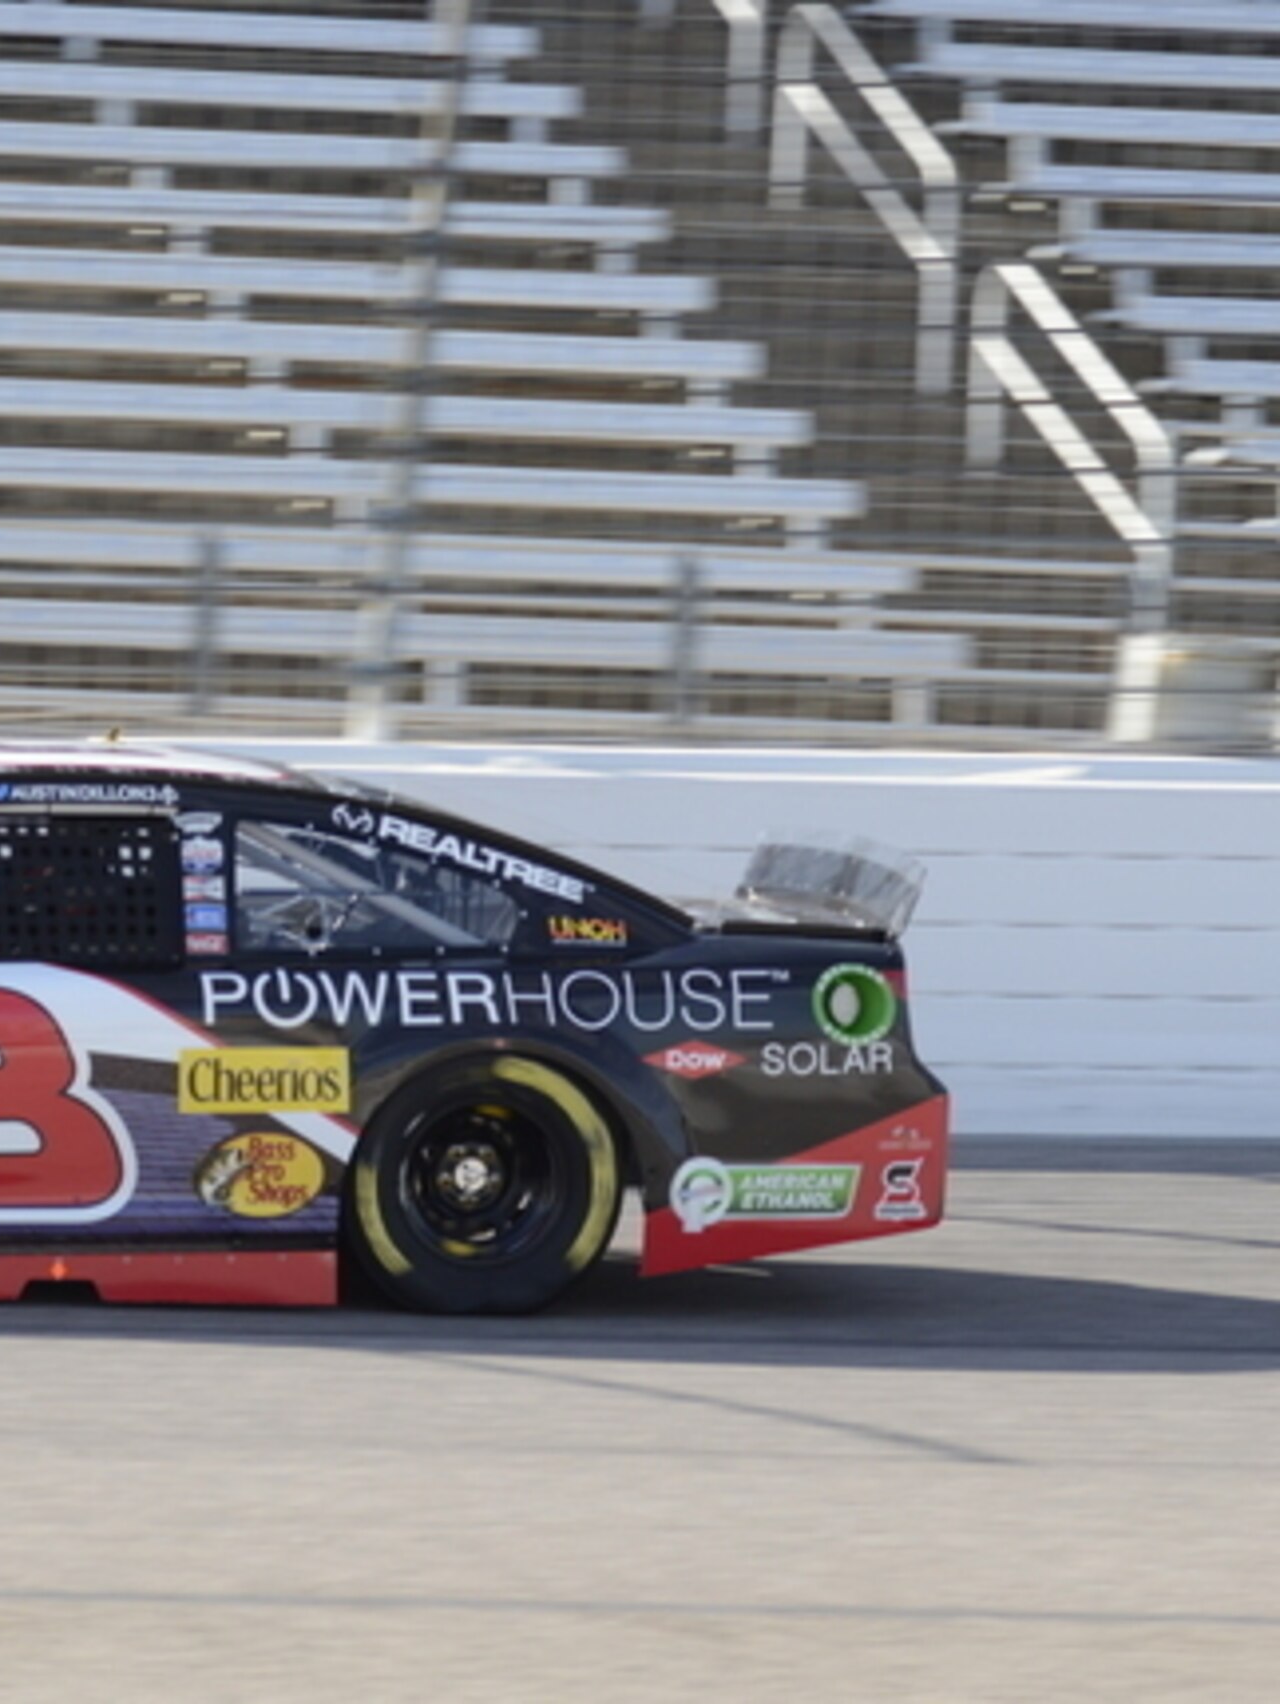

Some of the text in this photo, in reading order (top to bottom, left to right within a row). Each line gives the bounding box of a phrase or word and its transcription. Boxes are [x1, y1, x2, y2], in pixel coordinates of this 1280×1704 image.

[379, 816, 584, 904] REALTREE
[761, 1042, 893, 1075] SOLAR
[187, 1056, 342, 1104] Cheerios
[247, 1136, 294, 1161] Bass
[740, 1173, 847, 1190] AMERICAN
[247, 1184, 309, 1208] Shops
[740, 1193, 836, 1211] ETHANOL
